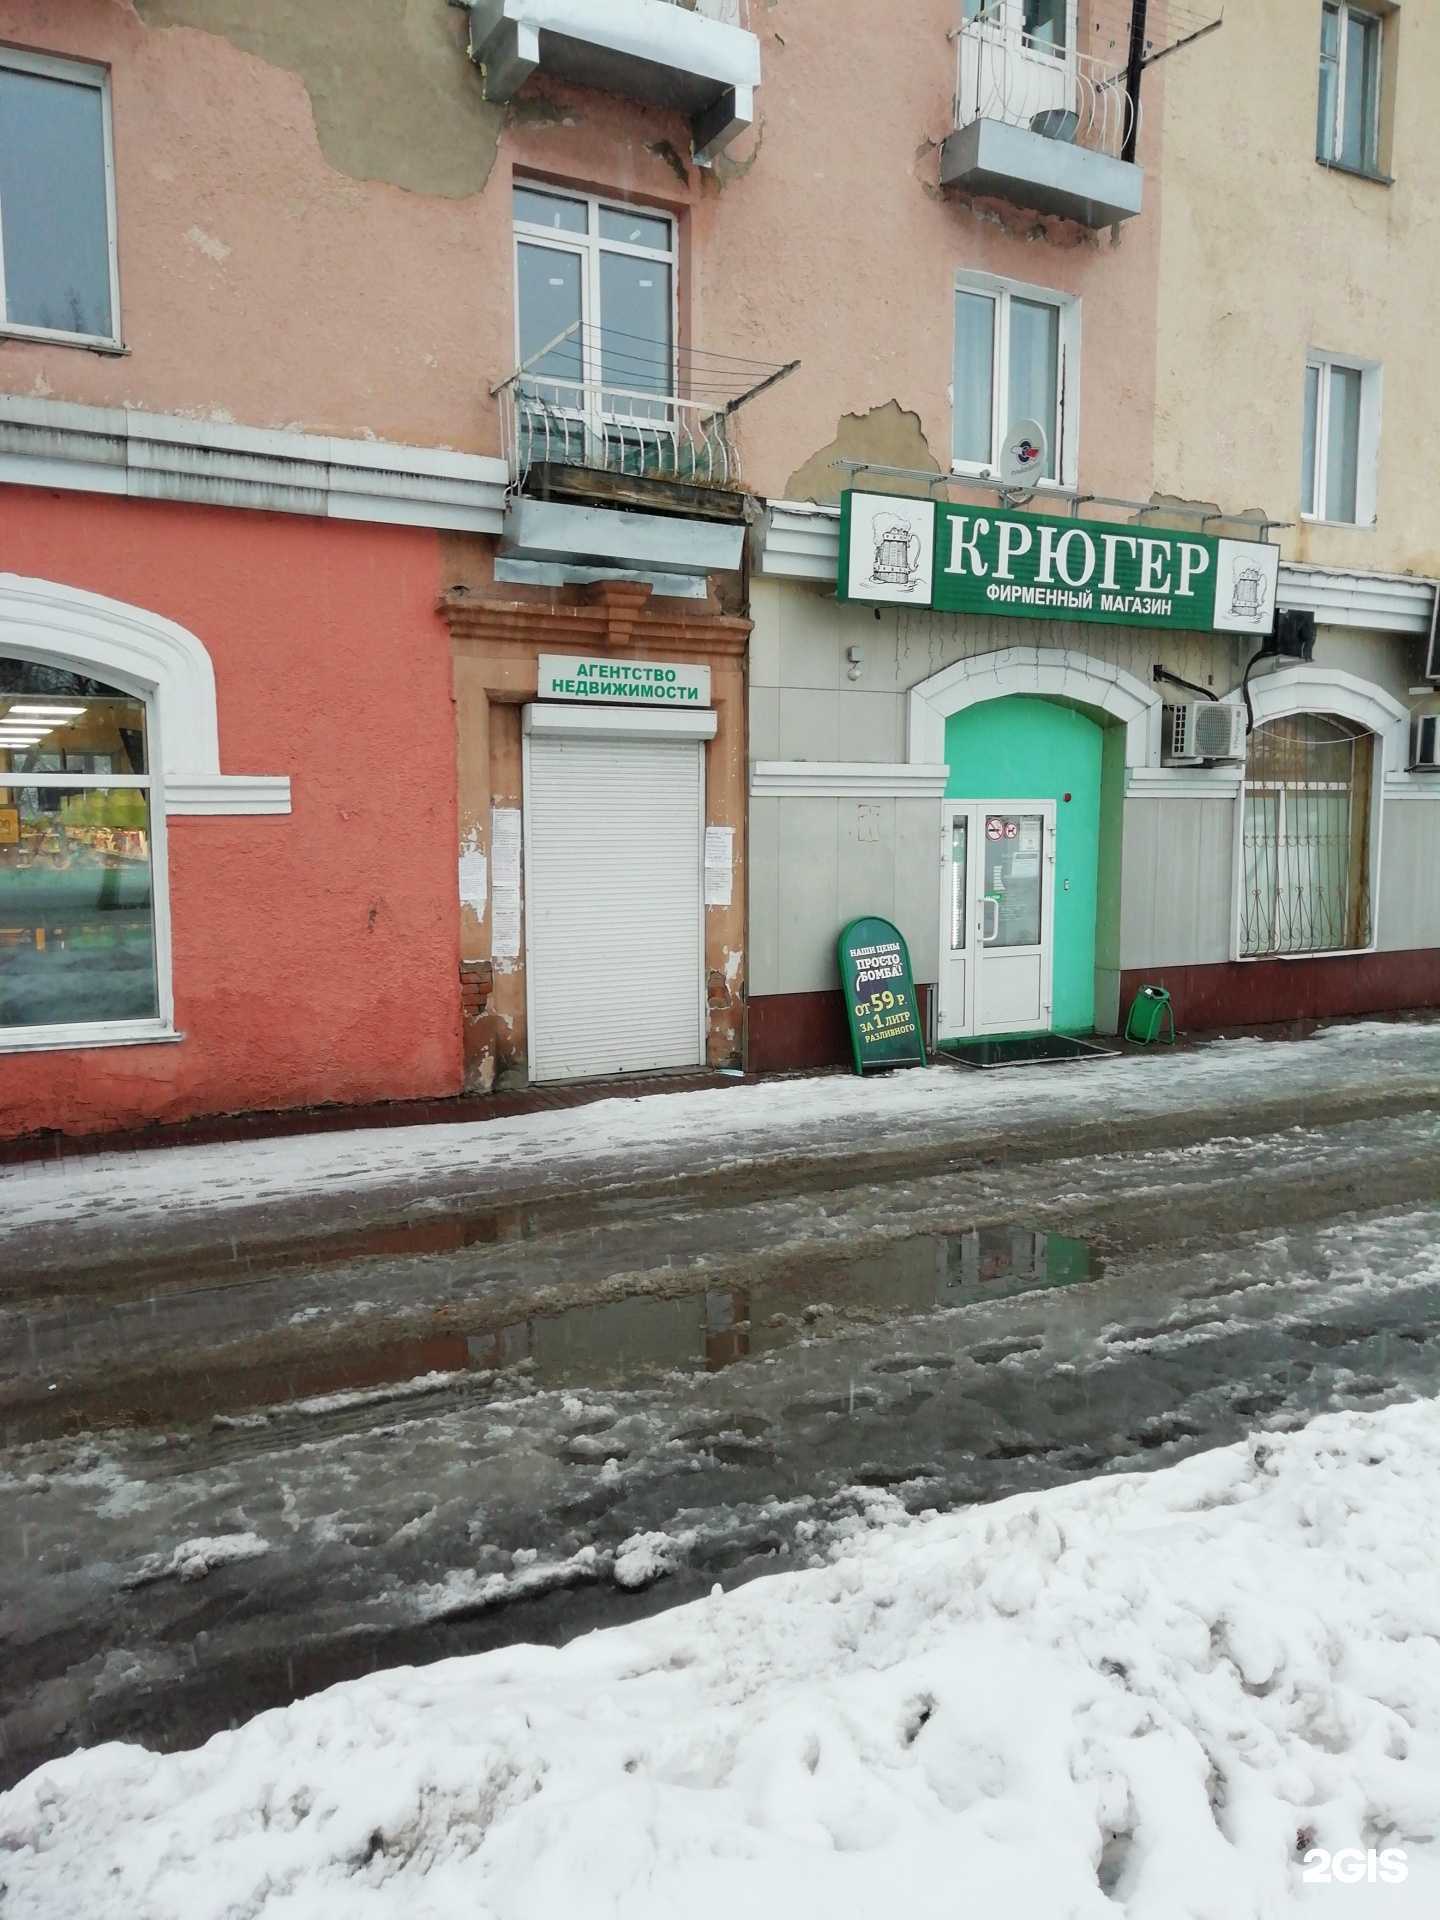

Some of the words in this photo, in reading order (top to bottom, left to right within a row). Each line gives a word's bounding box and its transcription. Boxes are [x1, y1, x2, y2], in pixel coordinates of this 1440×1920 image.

[944, 514, 1210, 596] КРЮГЕР
[986, 583, 1093, 609] ФИРМЕННЫЙ
[1100, 594, 1171, 616] МАГАЗИН
[577, 663, 676, 682] АГЕНТСТВО
[552, 679, 698, 700] НЕДВИЖИМОСТИ
[849, 946, 876, 957] НАШИ
[876, 942, 900, 954] ЦЕНЫ
[856, 954, 900, 970] ПРОСТО
[855, 1002, 871, 1016] ОТ
[870, 990, 895, 1012] 59
[859, 1022, 874, 1033] ЗА
[873, 1014, 884, 1028] 1
[885, 1011, 910, 1026] ЛИТР
[865, 1023, 915, 1043] РАЗЛИВНОГО
